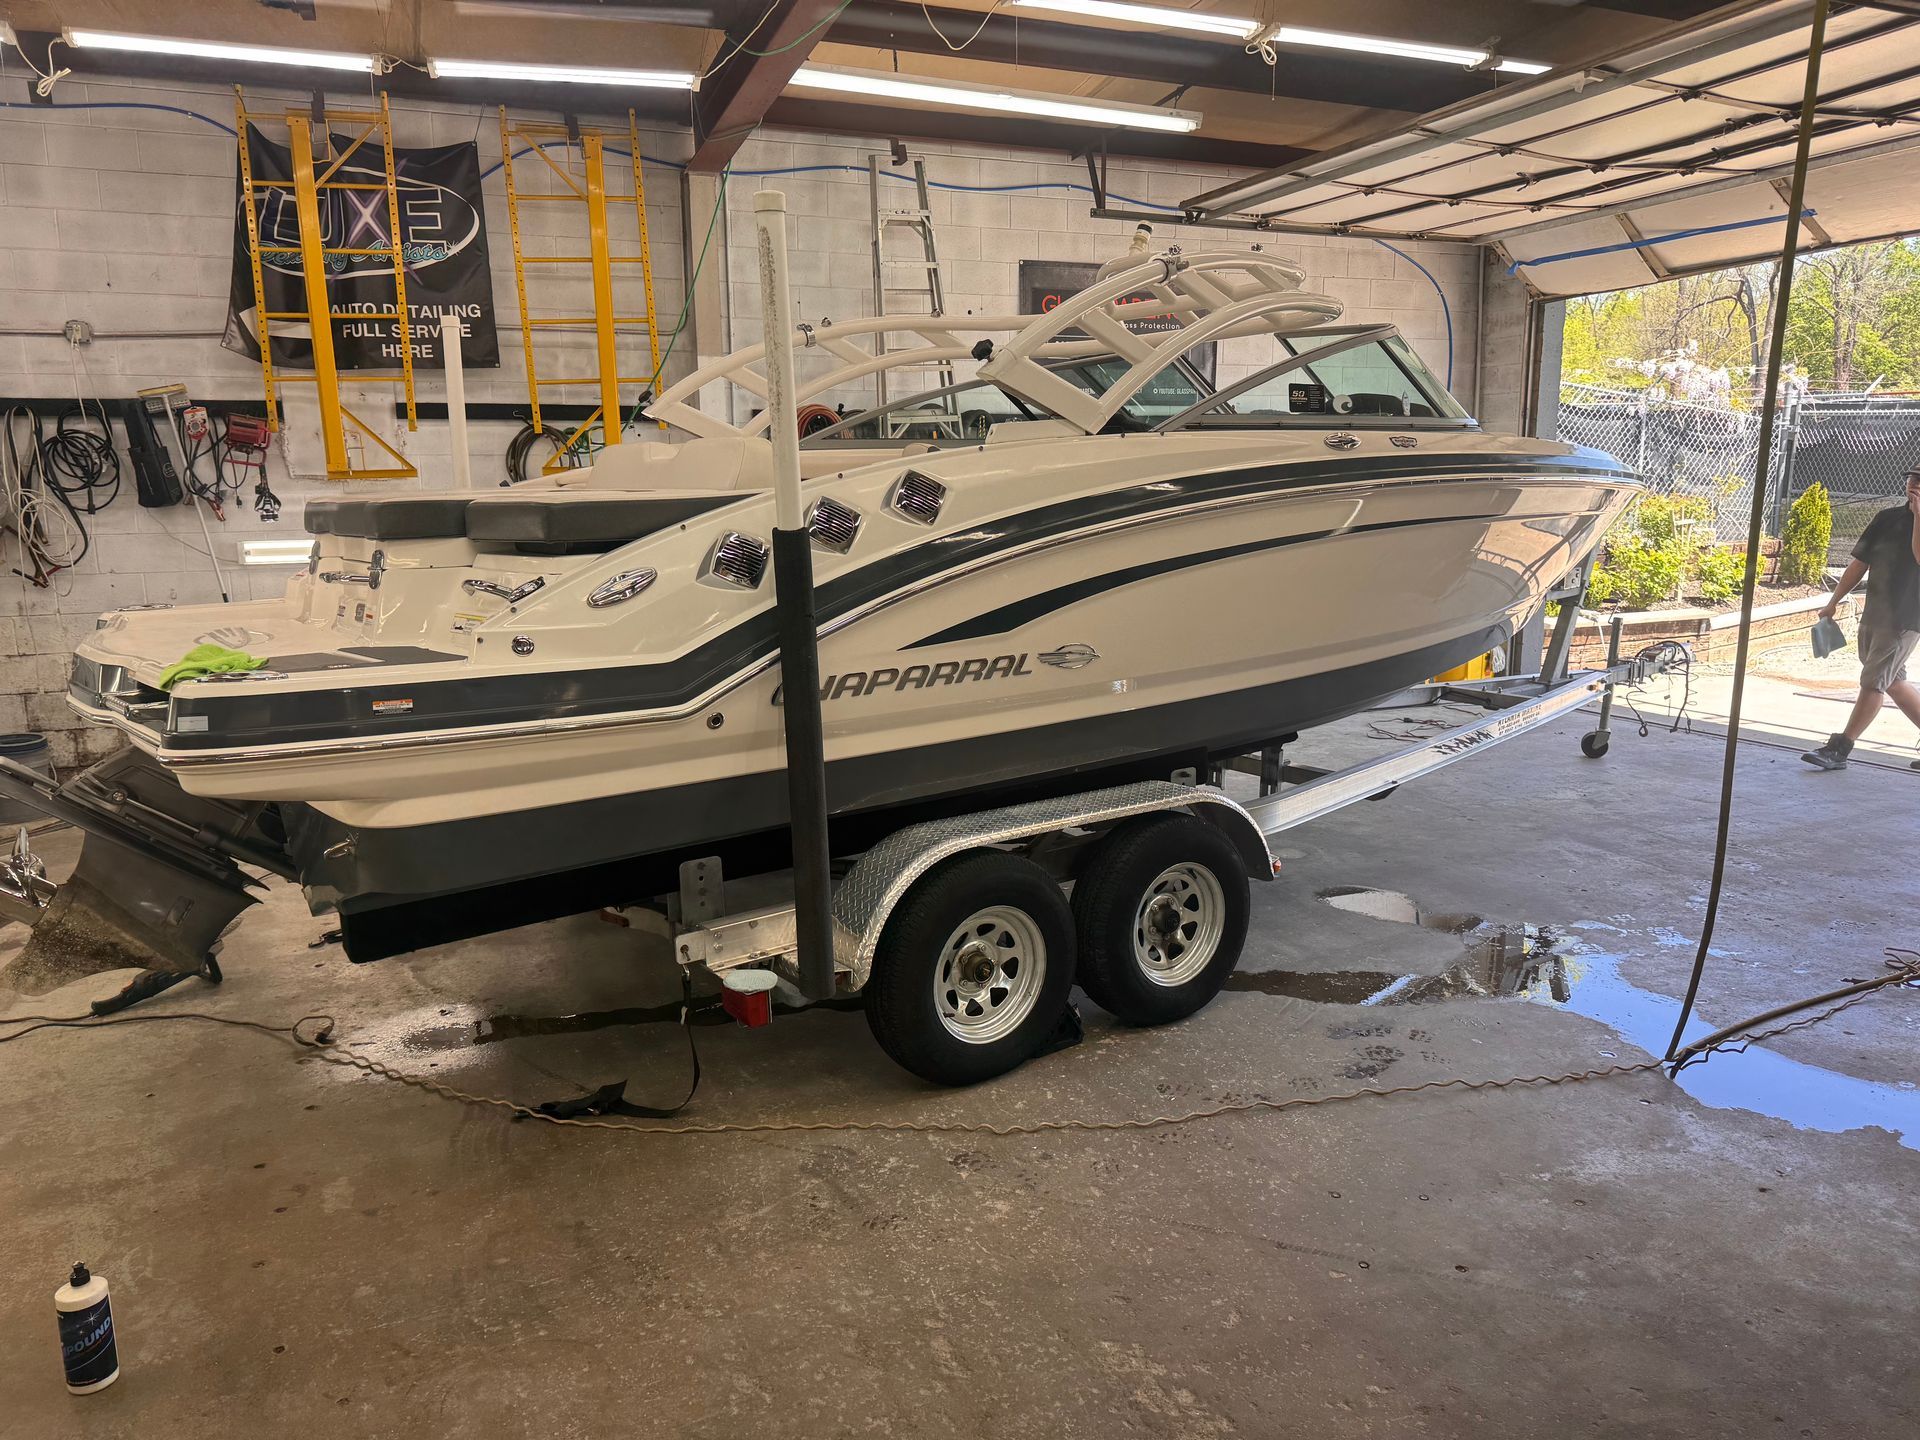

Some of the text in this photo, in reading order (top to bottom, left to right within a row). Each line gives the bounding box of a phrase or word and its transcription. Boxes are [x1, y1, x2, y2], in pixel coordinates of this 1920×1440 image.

[331, 303, 481, 318] AUTO DTAILING
[343, 323, 472, 339] FULL SERVE
[1140, 321, 1181, 330] Protection
